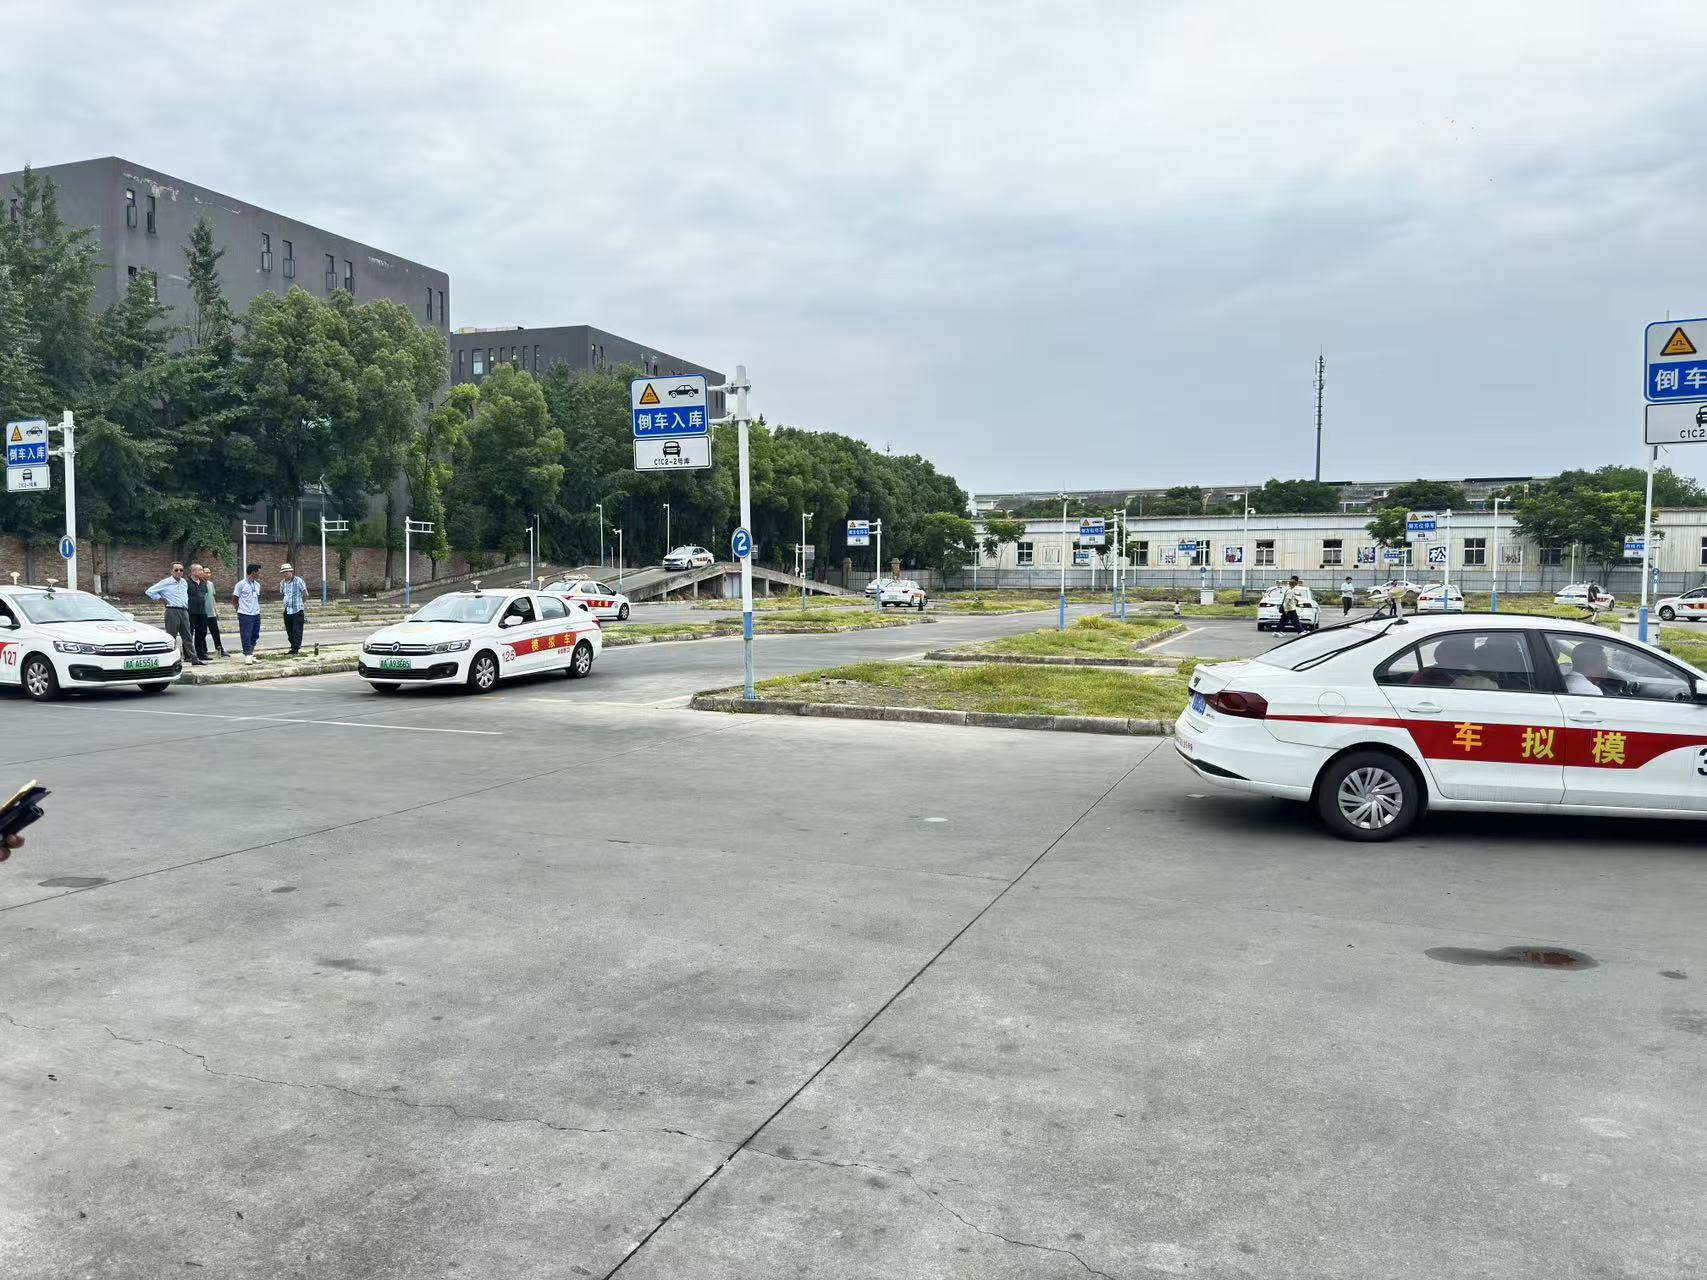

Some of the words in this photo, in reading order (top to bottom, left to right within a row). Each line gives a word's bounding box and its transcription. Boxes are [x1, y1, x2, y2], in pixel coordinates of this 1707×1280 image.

[1655, 368, 1707, 391] 倒车
[638, 411, 703, 430] 倒车入库
[10, 446, 45, 460] 倒车入库
[737, 532, 747, 551] 2
[3, 650, 16, 665] 127
[502, 650, 515, 662] 125
